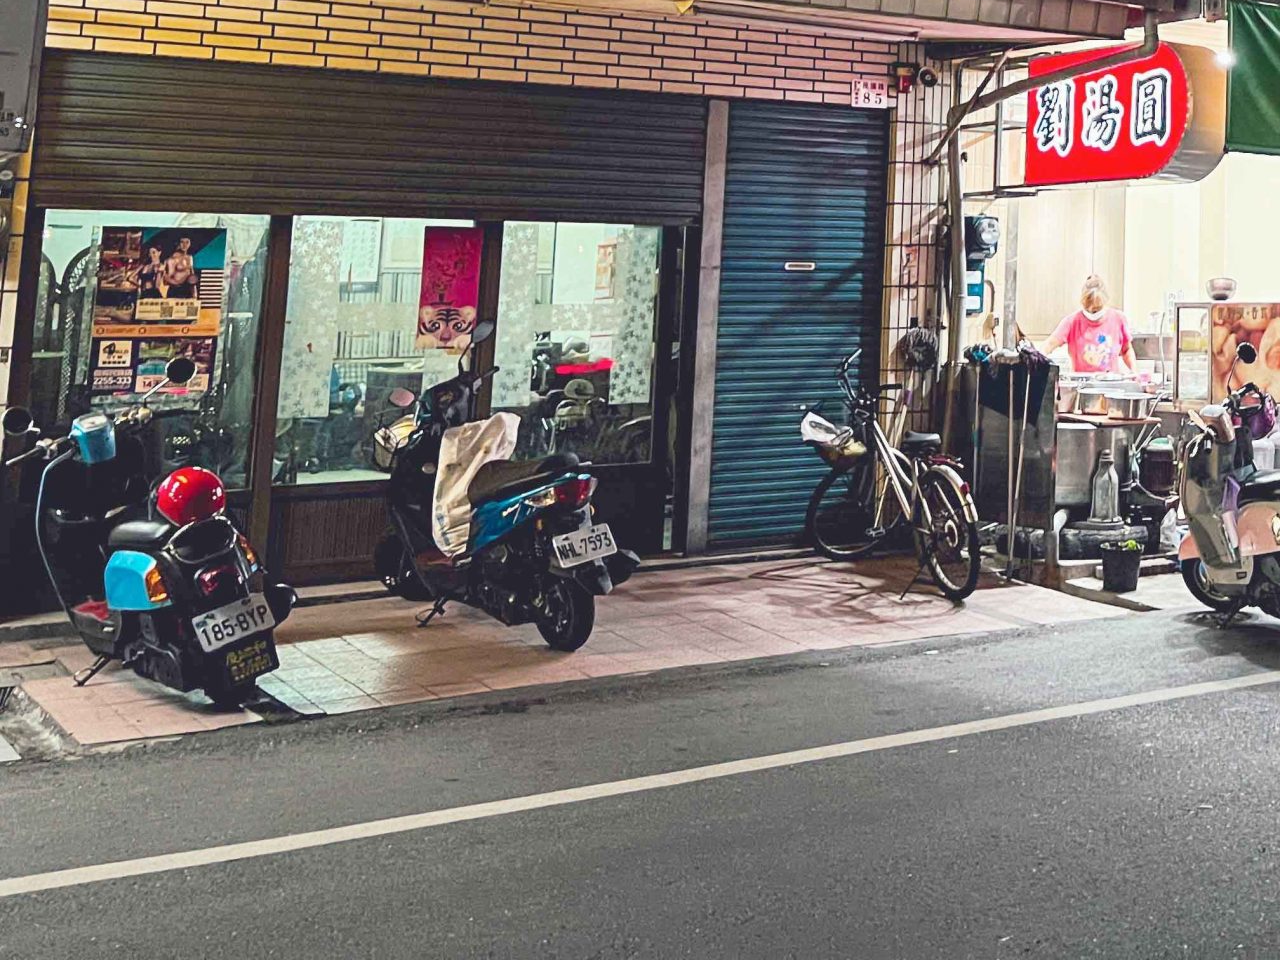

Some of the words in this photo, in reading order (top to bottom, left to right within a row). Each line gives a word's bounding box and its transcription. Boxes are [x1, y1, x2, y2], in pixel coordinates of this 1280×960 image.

[862, 91, 883, 106] 85
[1032, 66, 1172, 155] 劉湯圓
[557, 532, 612, 560] NHL-7593
[201, 605, 267, 646] 185-BYP
